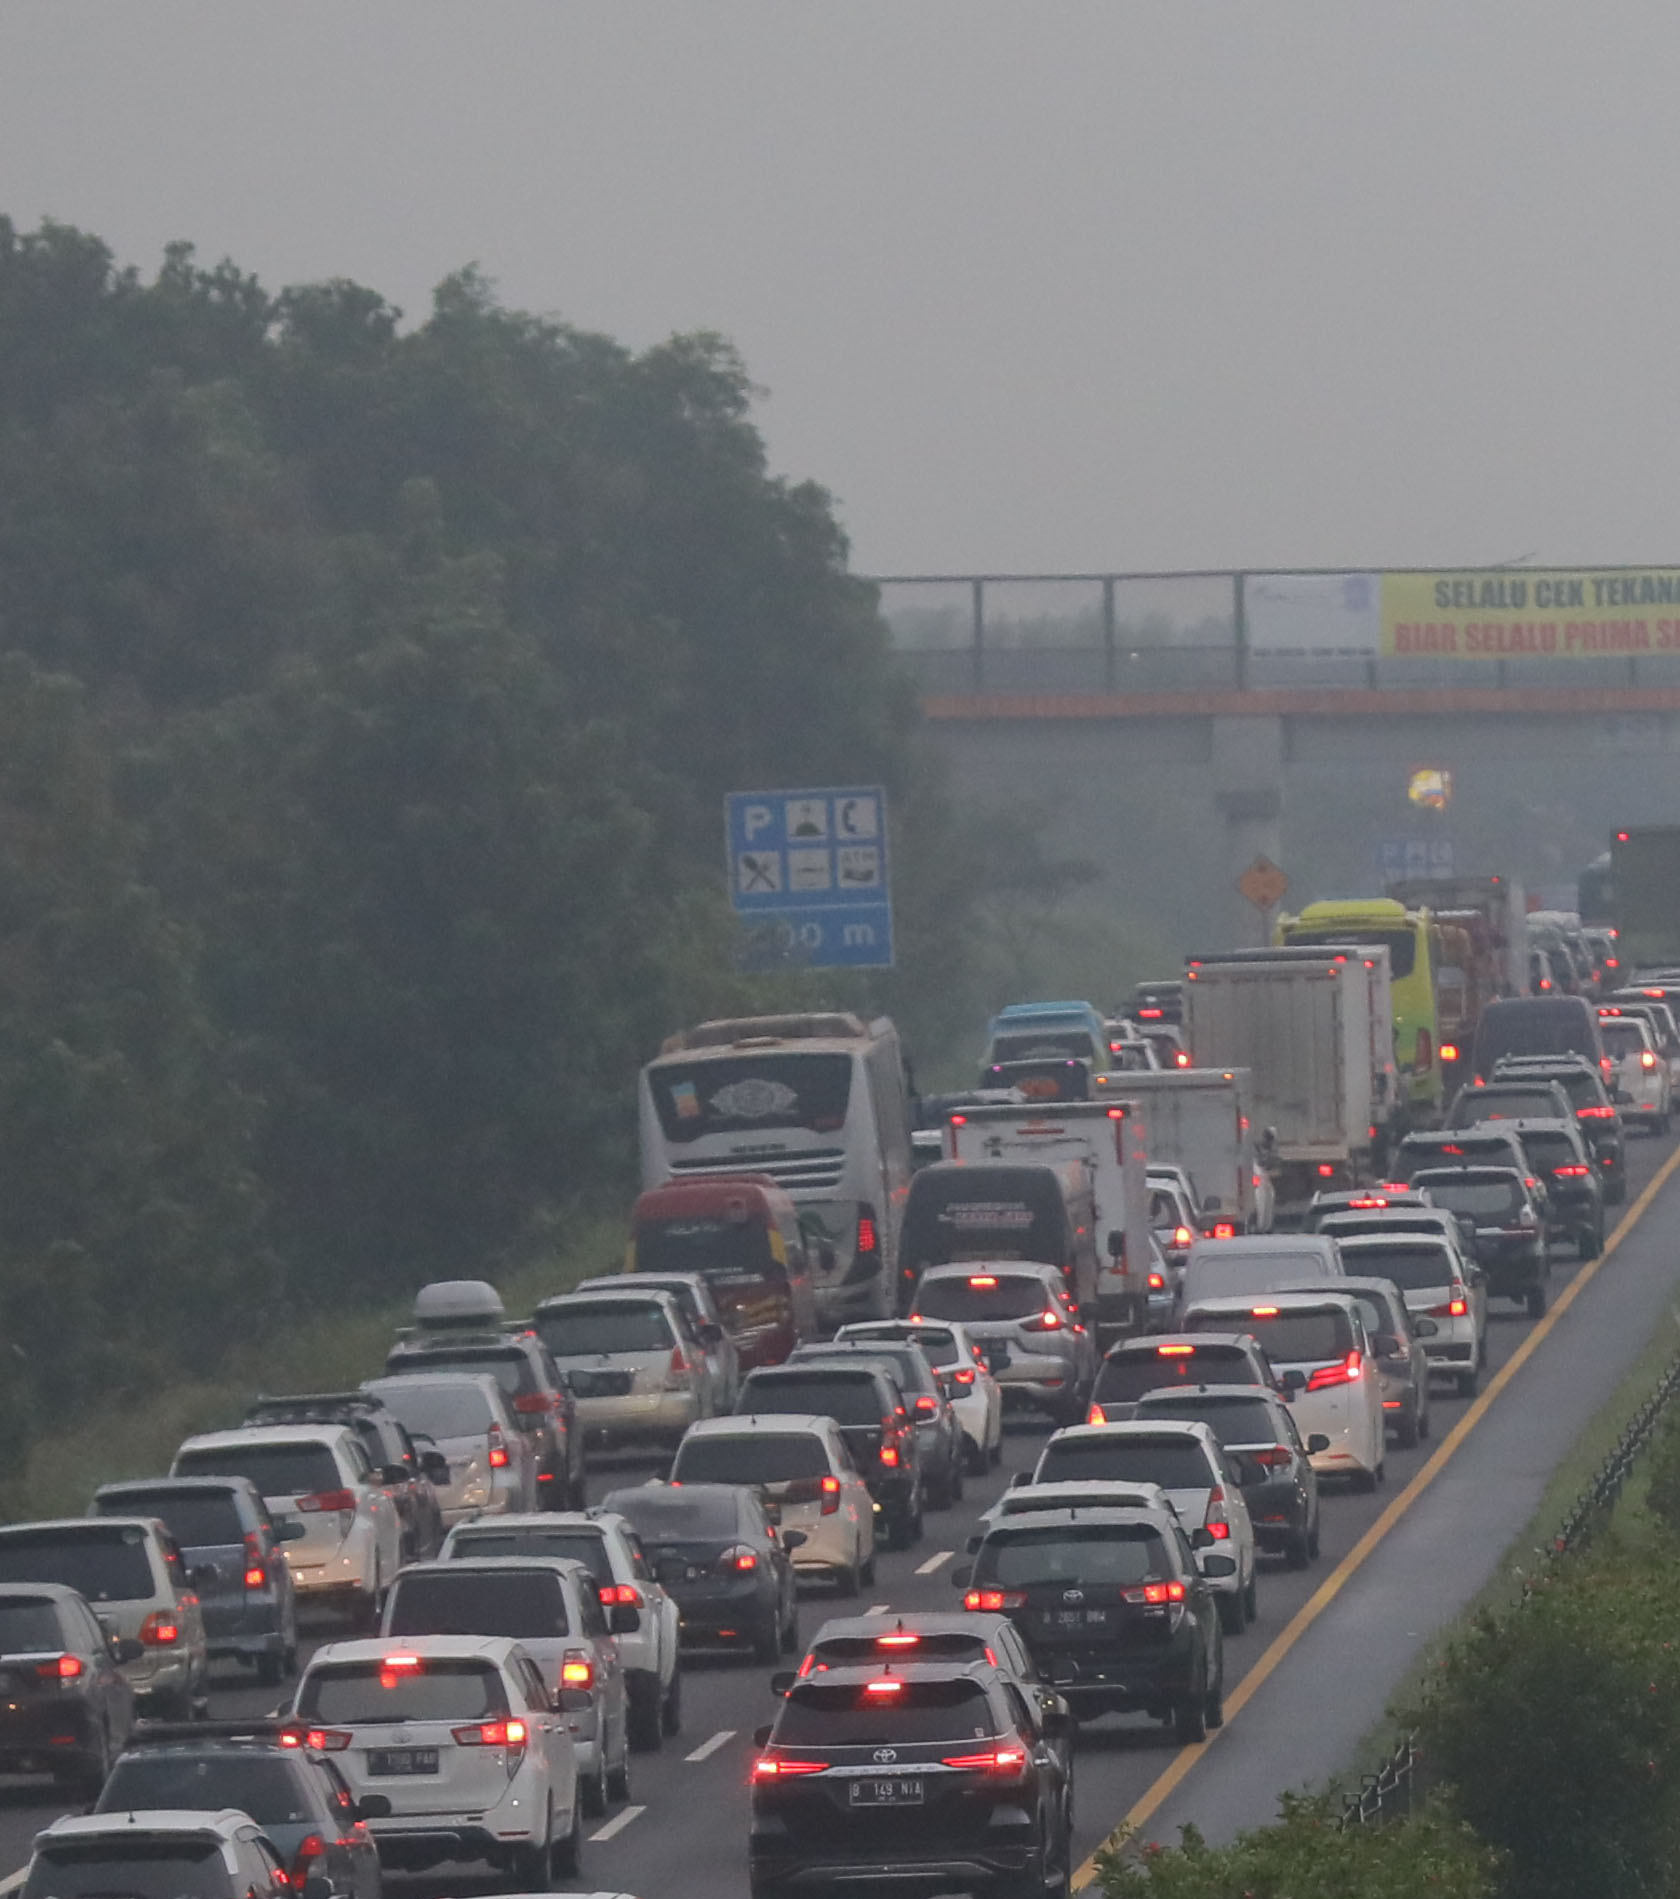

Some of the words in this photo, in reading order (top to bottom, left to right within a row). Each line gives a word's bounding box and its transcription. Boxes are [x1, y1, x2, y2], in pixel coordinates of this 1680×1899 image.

[1435, 580, 1527, 609] SELALU
[1535, 579, 1585, 608] CEK
[1394, 622, 1457, 652] BIAR
[1464, 621, 1558, 652] SELALU
[1564, 620, 1649, 650] PRIMA
